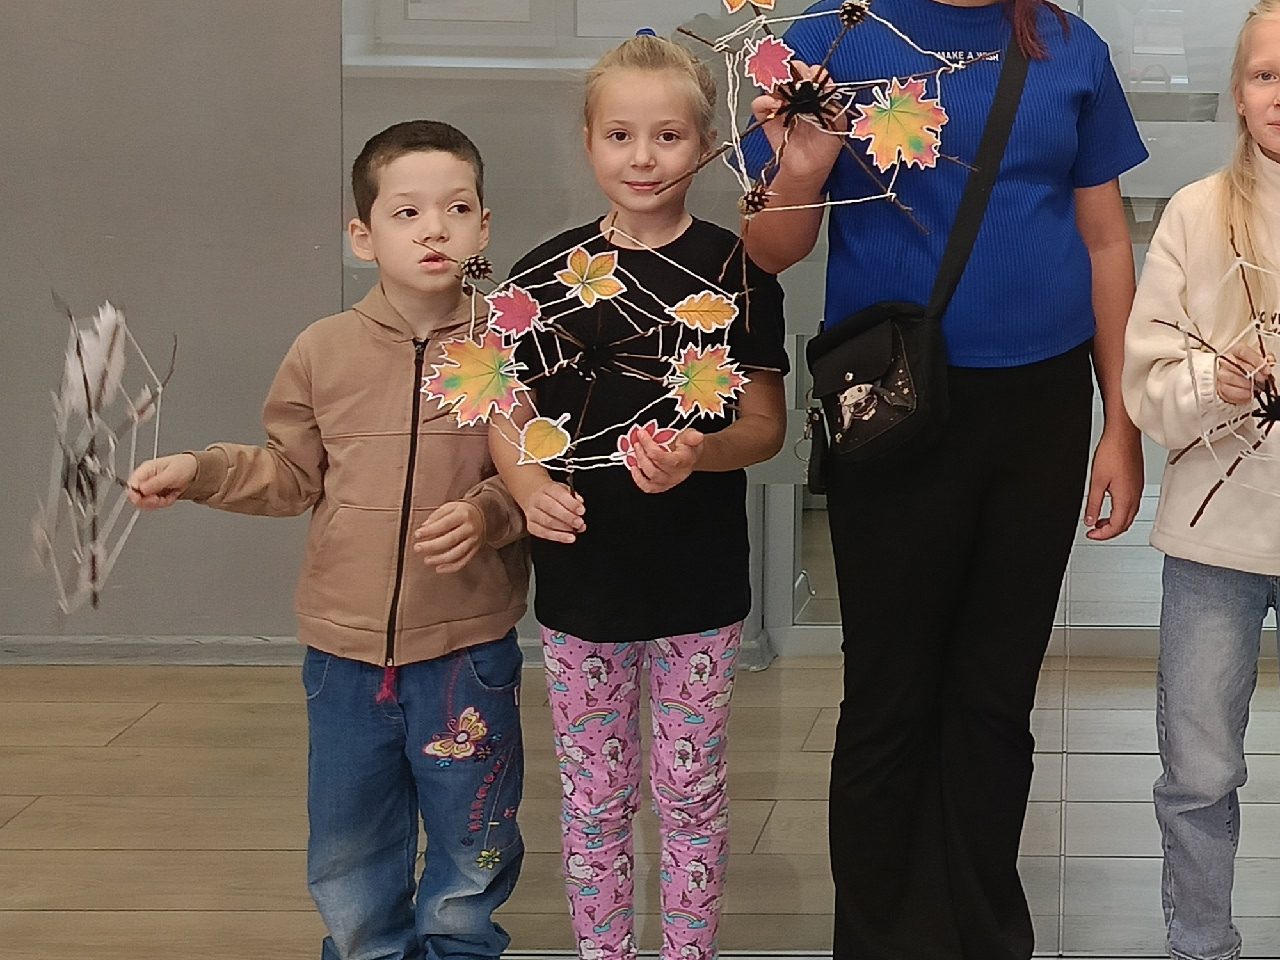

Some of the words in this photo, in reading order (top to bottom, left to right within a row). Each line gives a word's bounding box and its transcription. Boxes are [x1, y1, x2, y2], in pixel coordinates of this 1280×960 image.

[937, 50, 965, 60] MAKE
[966, 51, 974, 60] A
[976, 51, 999, 62] WH
